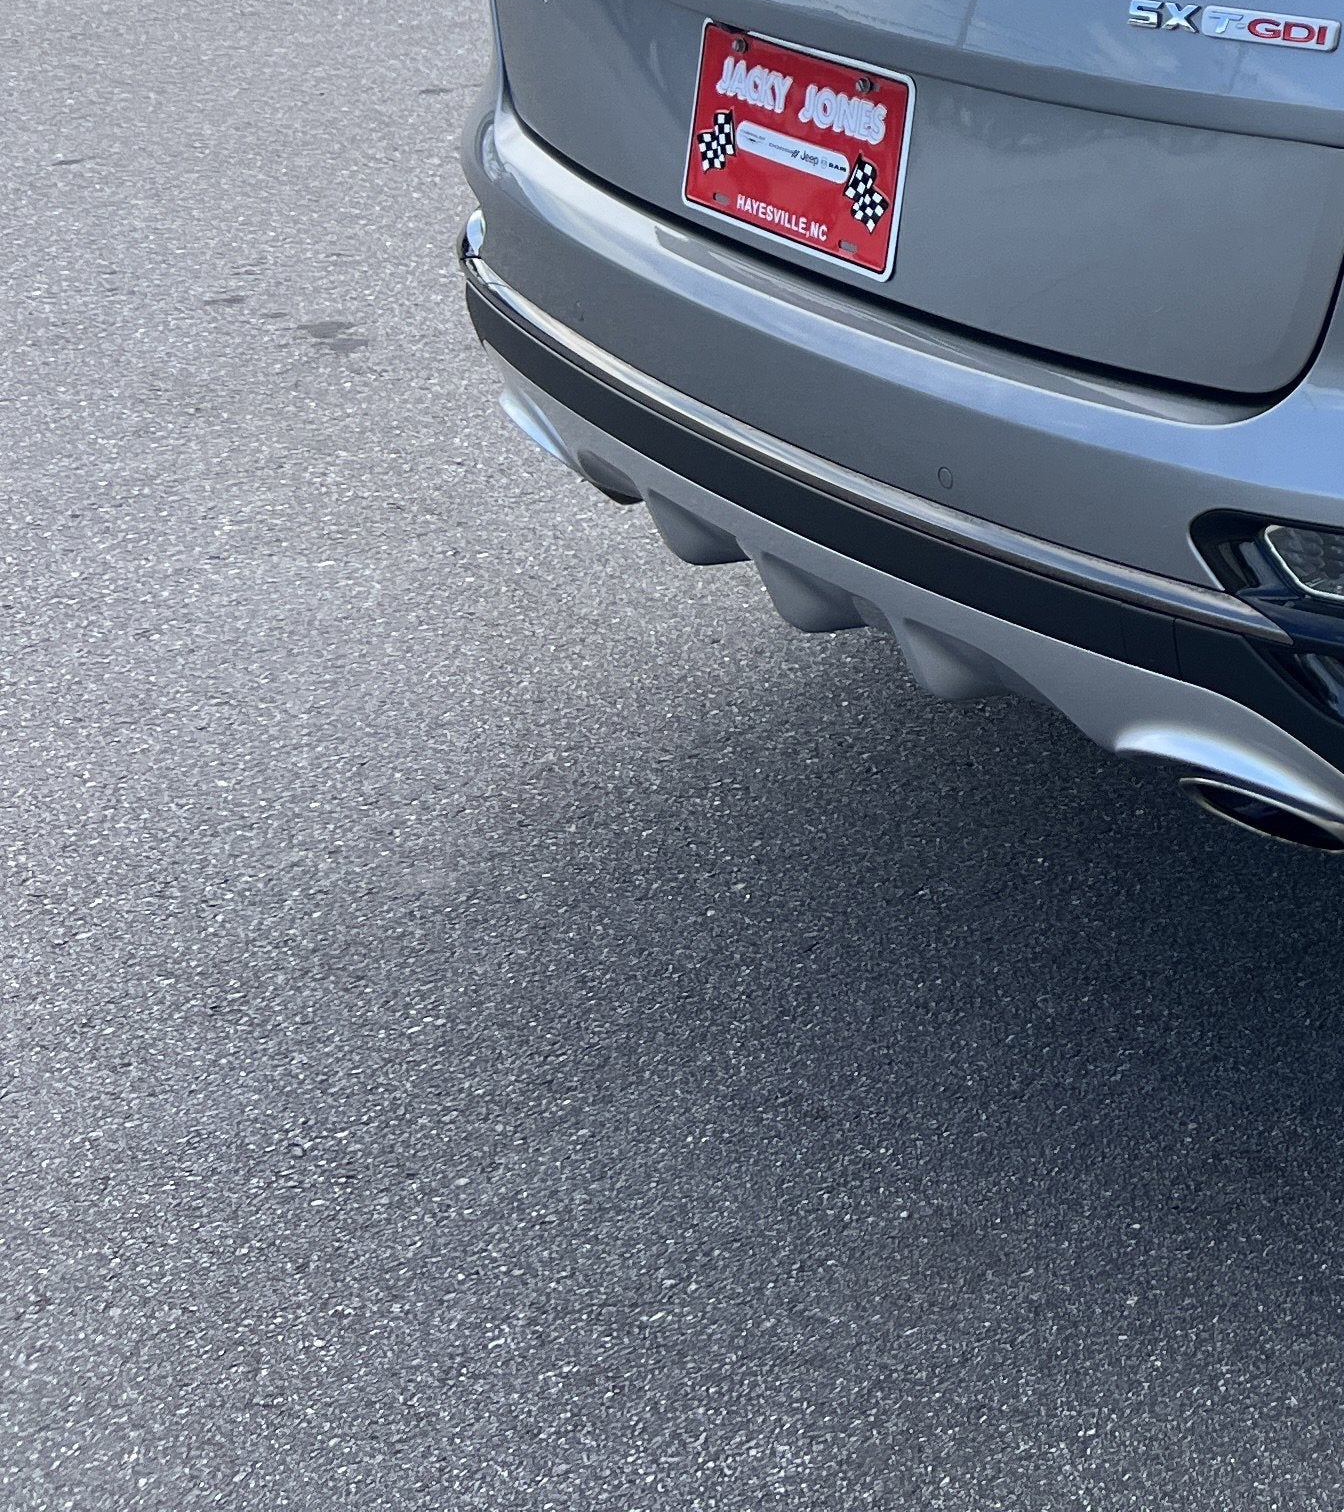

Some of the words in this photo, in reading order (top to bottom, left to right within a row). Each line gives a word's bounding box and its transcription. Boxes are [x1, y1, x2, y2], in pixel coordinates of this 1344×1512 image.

[716, 56, 793, 113] JACKY
[798, 84, 888, 145] JONES
[800, 150, 819, 166] Jeep
[828, 162, 847, 172] RAM
